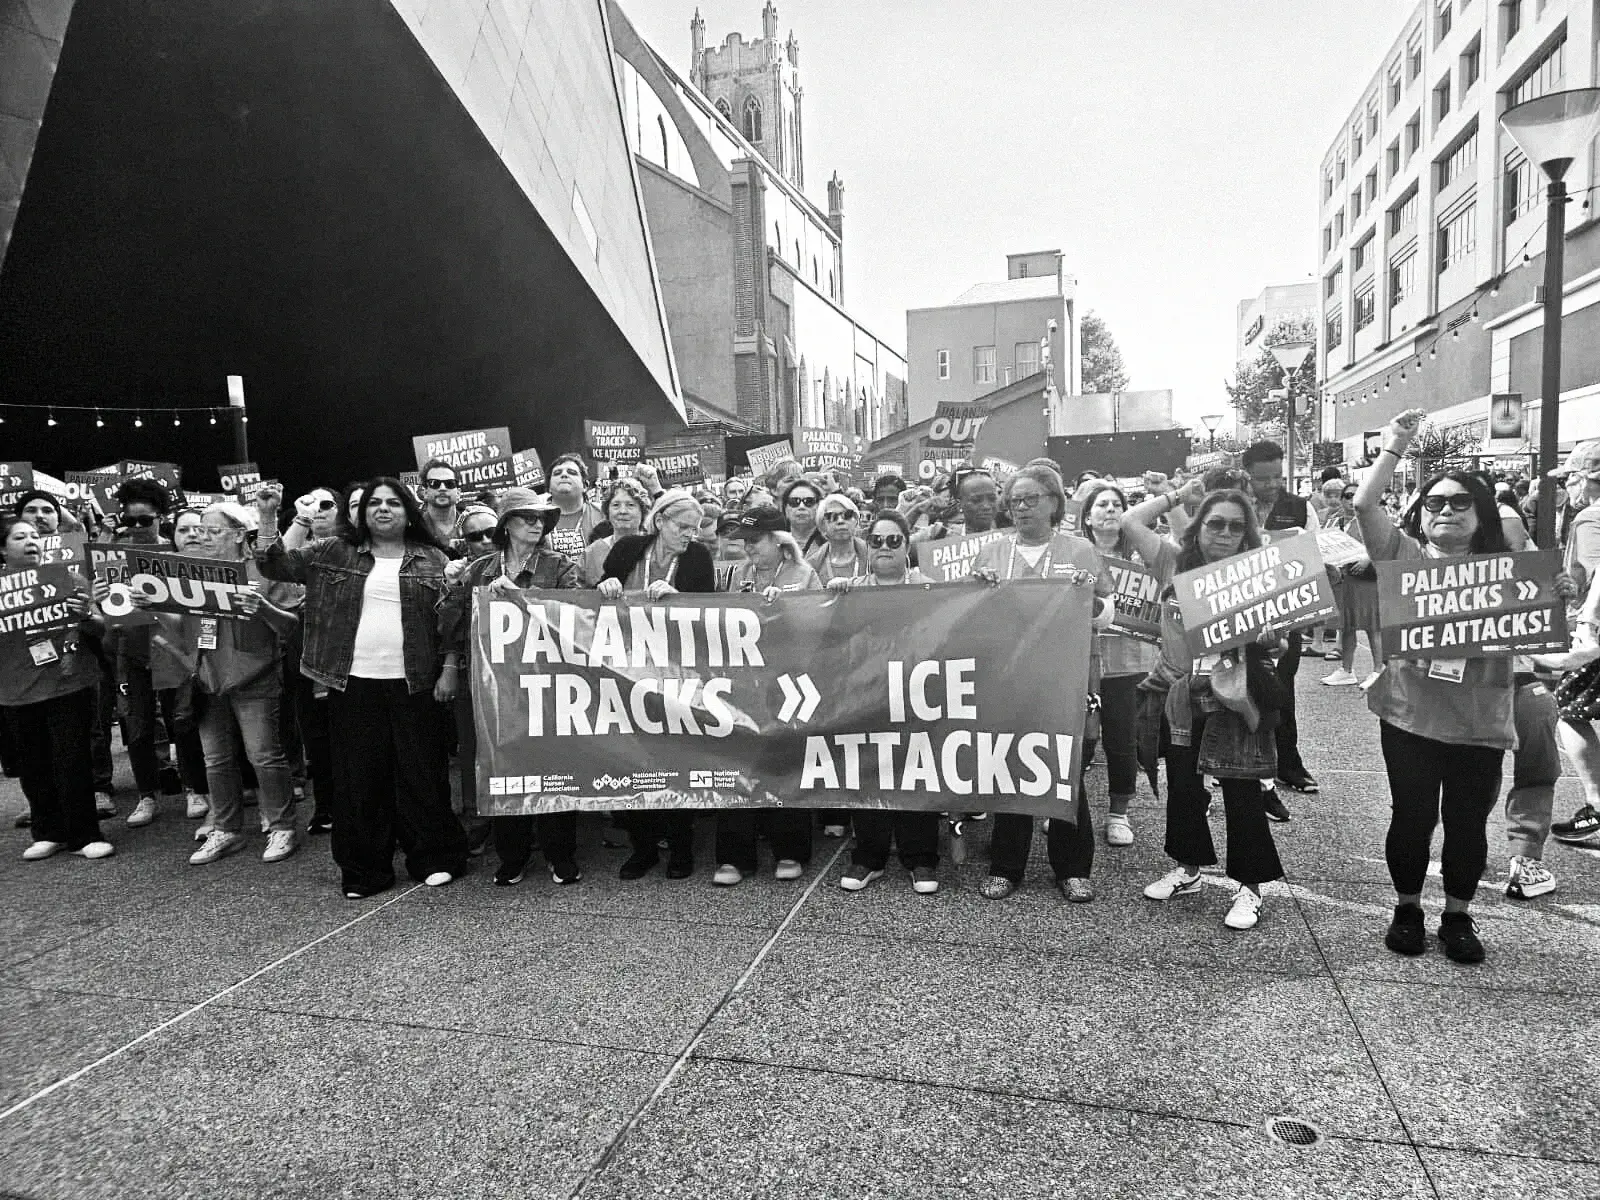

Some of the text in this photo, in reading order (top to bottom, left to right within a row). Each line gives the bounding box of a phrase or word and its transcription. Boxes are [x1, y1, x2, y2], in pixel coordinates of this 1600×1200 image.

[427, 431, 487, 457] PALANTIR
[592, 425, 630, 436] PALANTIR
[596, 436, 626, 447] TRACKS
[802, 431, 842, 443] PALANTIR
[928, 417, 989, 442] OUT
[604, 448, 641, 459] ATTACKS!
[808, 442, 839, 453] TRACKS
[458, 461, 508, 486] TTACKS!
[801, 455, 852, 470] ICE ATTACKS!
[64, 482, 97, 500] OU
[0, 569, 38, 592] NTIR
[136, 556, 238, 584] PALANTIR
[942, 557, 977, 582] TRA
[1109, 566, 1159, 602] TIEN
[1193, 546, 1282, 600] PALANTIR
[1401, 557, 1514, 596] PALANTIR
[130, 573, 250, 611] OUT
[1207, 569, 1278, 616] TRACKS
[1414, 584, 1503, 618] TRACKS
[0, 602, 70, 633] ATTACKS!
[1202, 618, 1233, 648] ICE
[1234, 580, 1321, 636] ATTACKS!
[489, 600, 765, 668] PALANTIR
[1400, 608, 1552, 652] ICE ATTACKS!
[887, 657, 978, 723] ICE
[519, 673, 734, 738] TRACKS
[799, 729, 1074, 802] ATTACKS!
